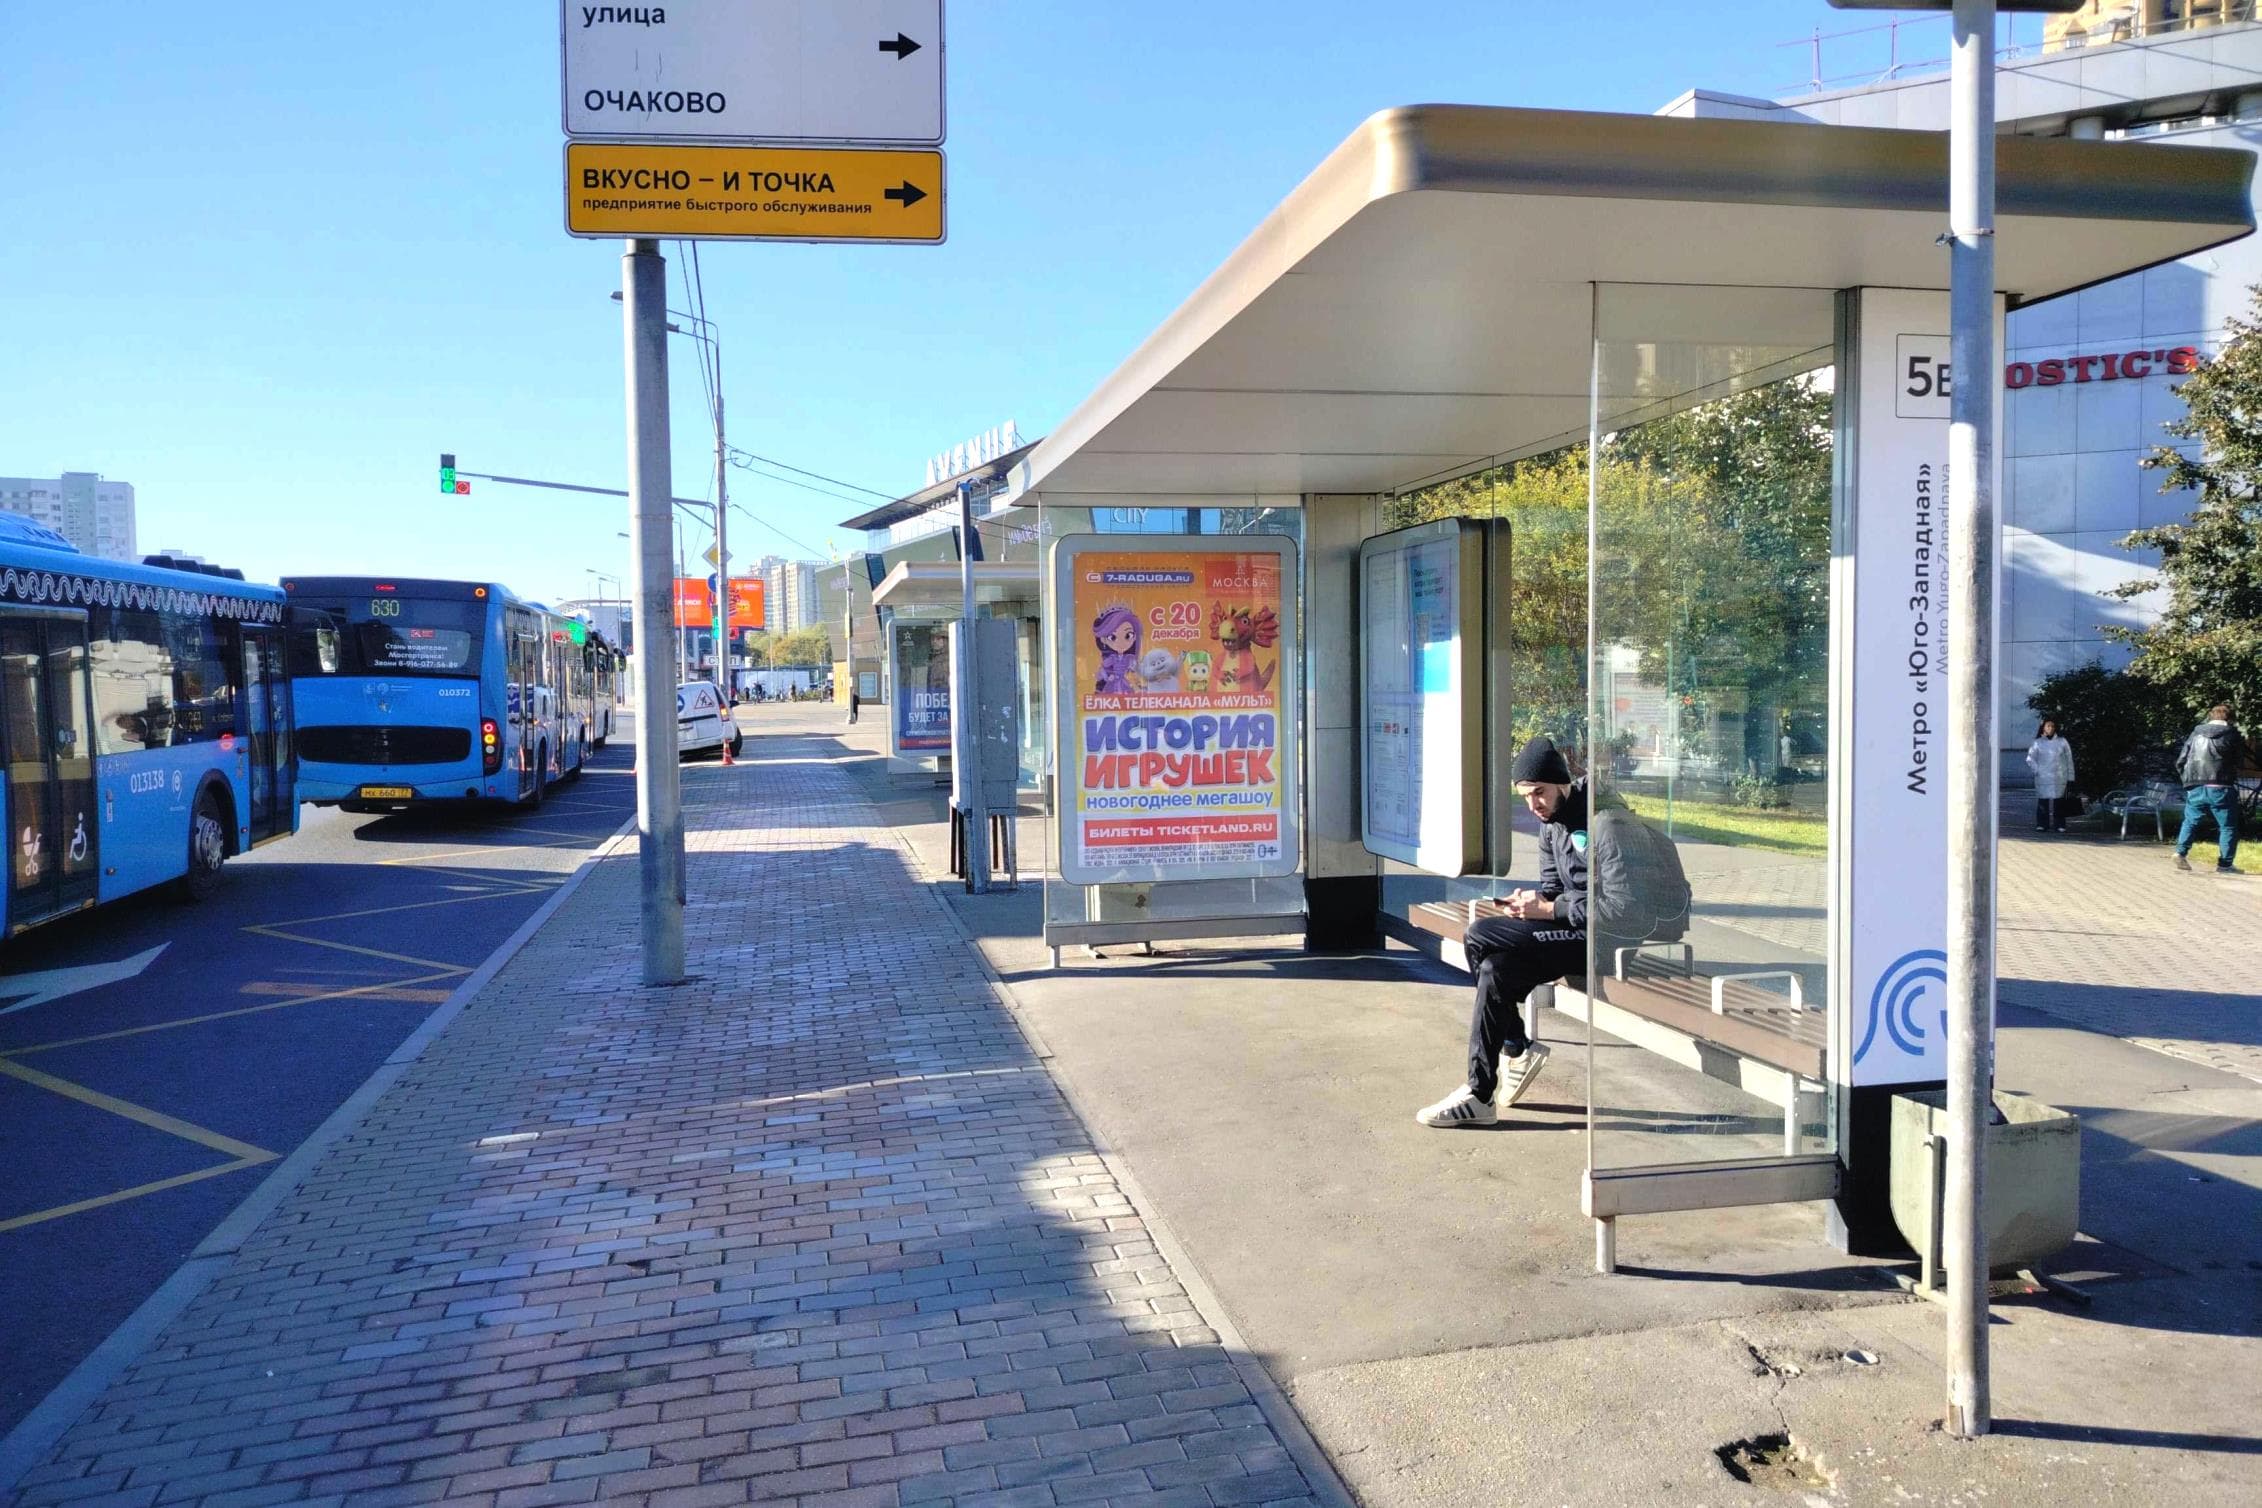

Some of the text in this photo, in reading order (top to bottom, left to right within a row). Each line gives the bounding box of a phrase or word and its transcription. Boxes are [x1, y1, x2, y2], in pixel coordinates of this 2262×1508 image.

[583, 6, 666, 28] улица
[584, 89, 727, 115] ОЧАКОВО
[583, 168, 690, 191] ВКУСНО
[723, 171, 740, 192] И
[748, 171, 836, 194] ТОЧКА
[583, 198, 873, 216] предприятие быстрого обслуживания
[2006, 346, 2198, 389] OSTIC'S
[1113, 507, 1150, 524] CITY
[1213, 577, 1268, 588] МОСКВА
[371, 599, 400, 617] 630
[1170, 602, 1201, 626] 20
[1152, 629, 1200, 640] декабря
[1907, 463, 1932, 794] Метро «Юго-Западная»
[1936, 619, 1949, 676] Metro
[439, 688, 471, 697] 010372
[915, 693, 950, 709] ПОБЕ
[1085, 695, 1272, 711] ЁЛКА ТЕЛЕКАНАЛА «МУЛЬТ»
[908, 711, 949, 723] БУДЕТ ЗА
[1085, 714, 1274, 752] ИСТОРИЯ
[1084, 751, 1275, 789] ИГРУШЕК
[130, 770, 164, 794] 013138
[1087, 791, 1274, 810] новогоднее мегашоу
[1089, 823, 1272, 839] БИЛЕТЫ TICKETLAND.RU
[1258, 844, 1278, 858] 0+
